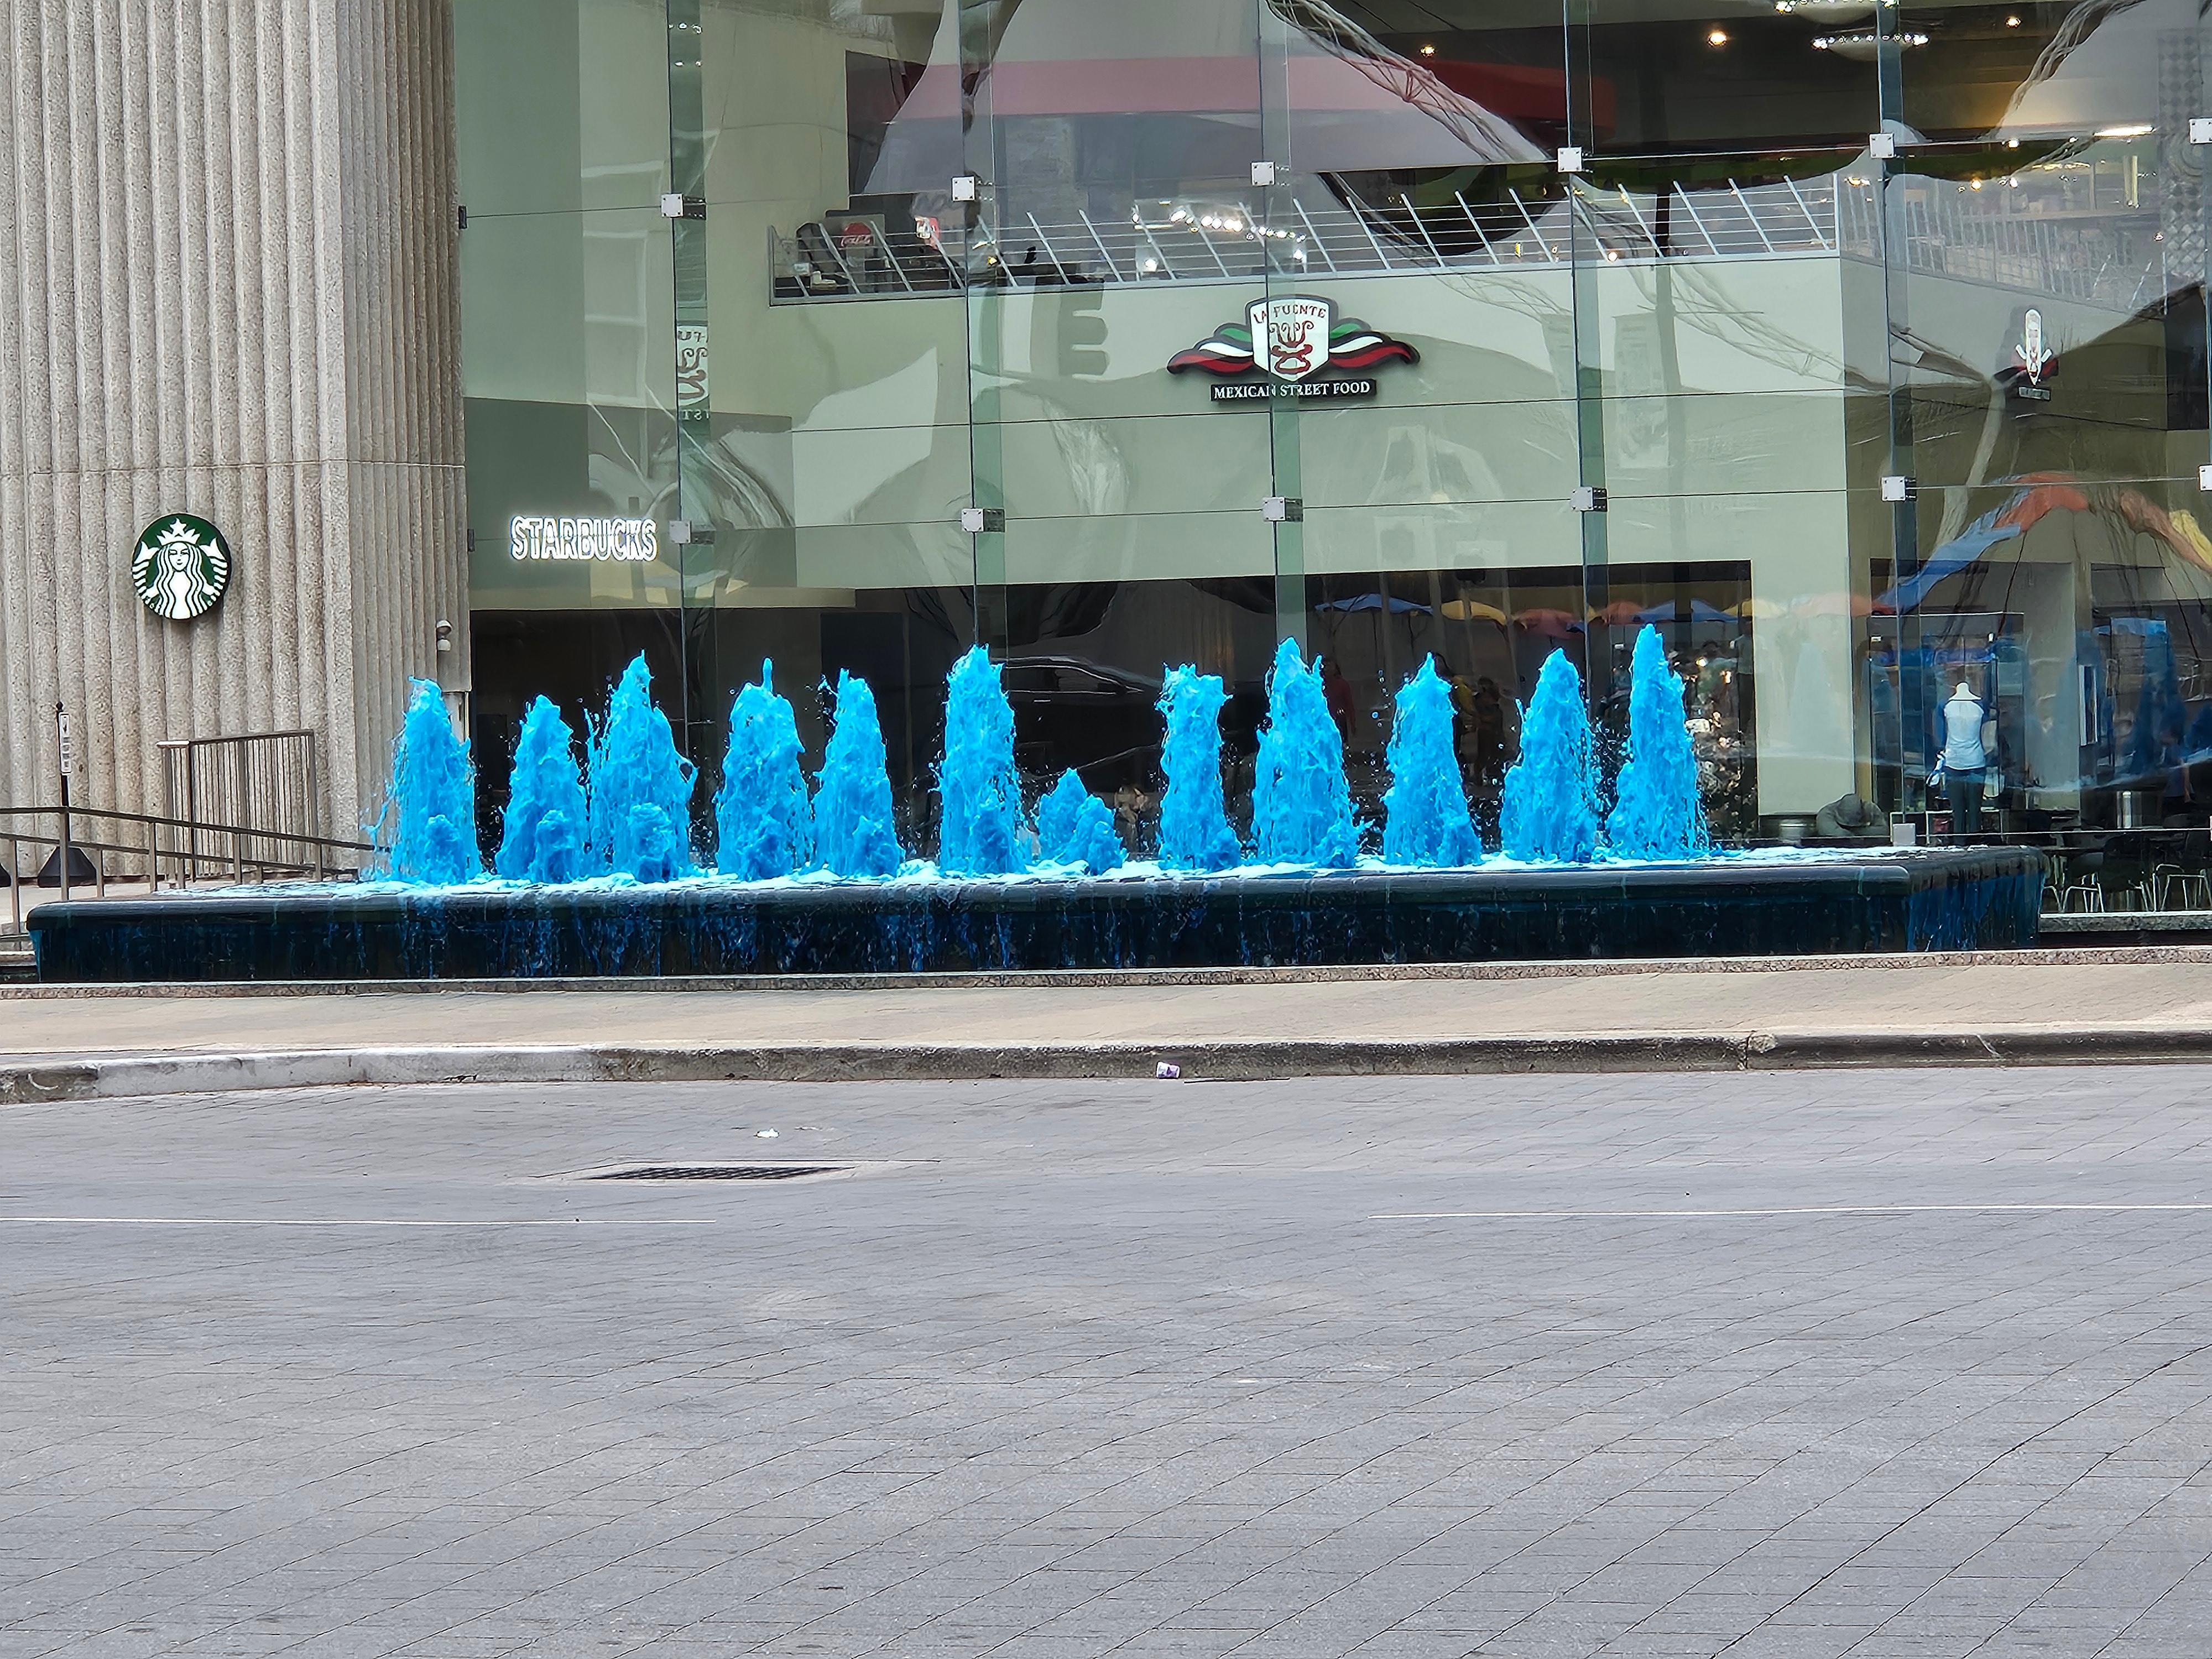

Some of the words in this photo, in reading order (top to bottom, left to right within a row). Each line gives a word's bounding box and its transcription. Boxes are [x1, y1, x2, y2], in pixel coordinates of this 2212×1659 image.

[1253, 310, 1267, 324] LA
[1274, 305, 1327, 319] FUENTE
[1214, 384, 1276, 399] MEXICAN
[1280, 384, 1329, 397] STREET
[1333, 381, 1370, 394] FOOD
[511, 516, 658, 561] STARBUCKS
